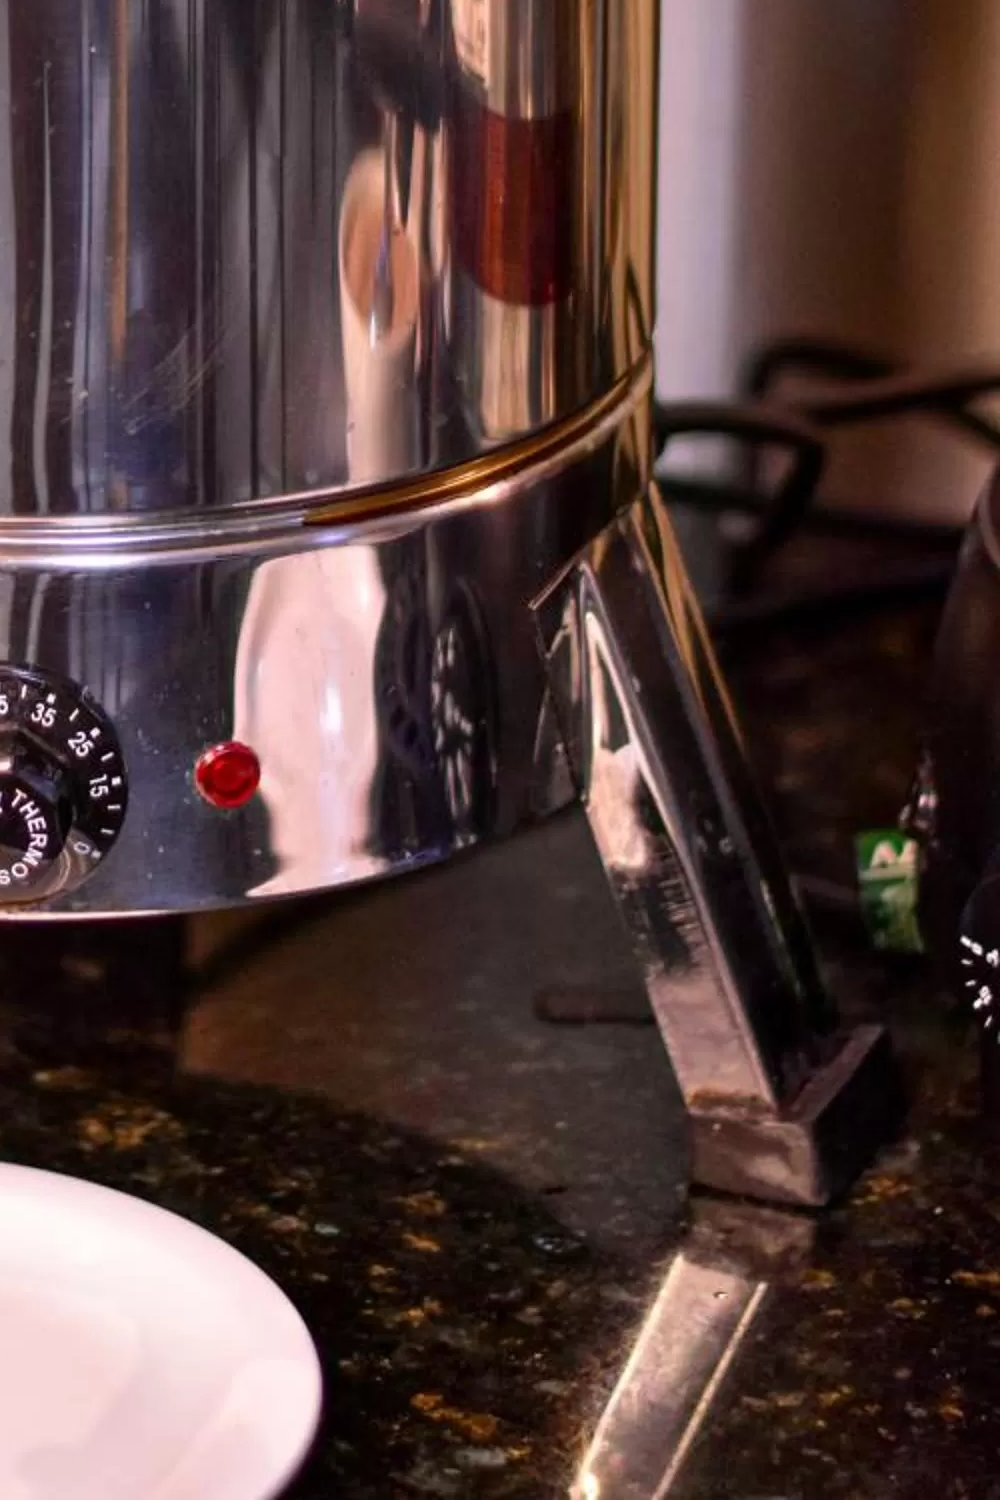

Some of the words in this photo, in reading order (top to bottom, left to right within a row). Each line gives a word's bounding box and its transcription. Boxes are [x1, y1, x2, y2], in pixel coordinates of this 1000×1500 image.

[31, 703, 57, 728] 35
[67, 731, 94, 757] 25
[89, 774, 109, 798] 15
[72, 841, 91, 855] 0
